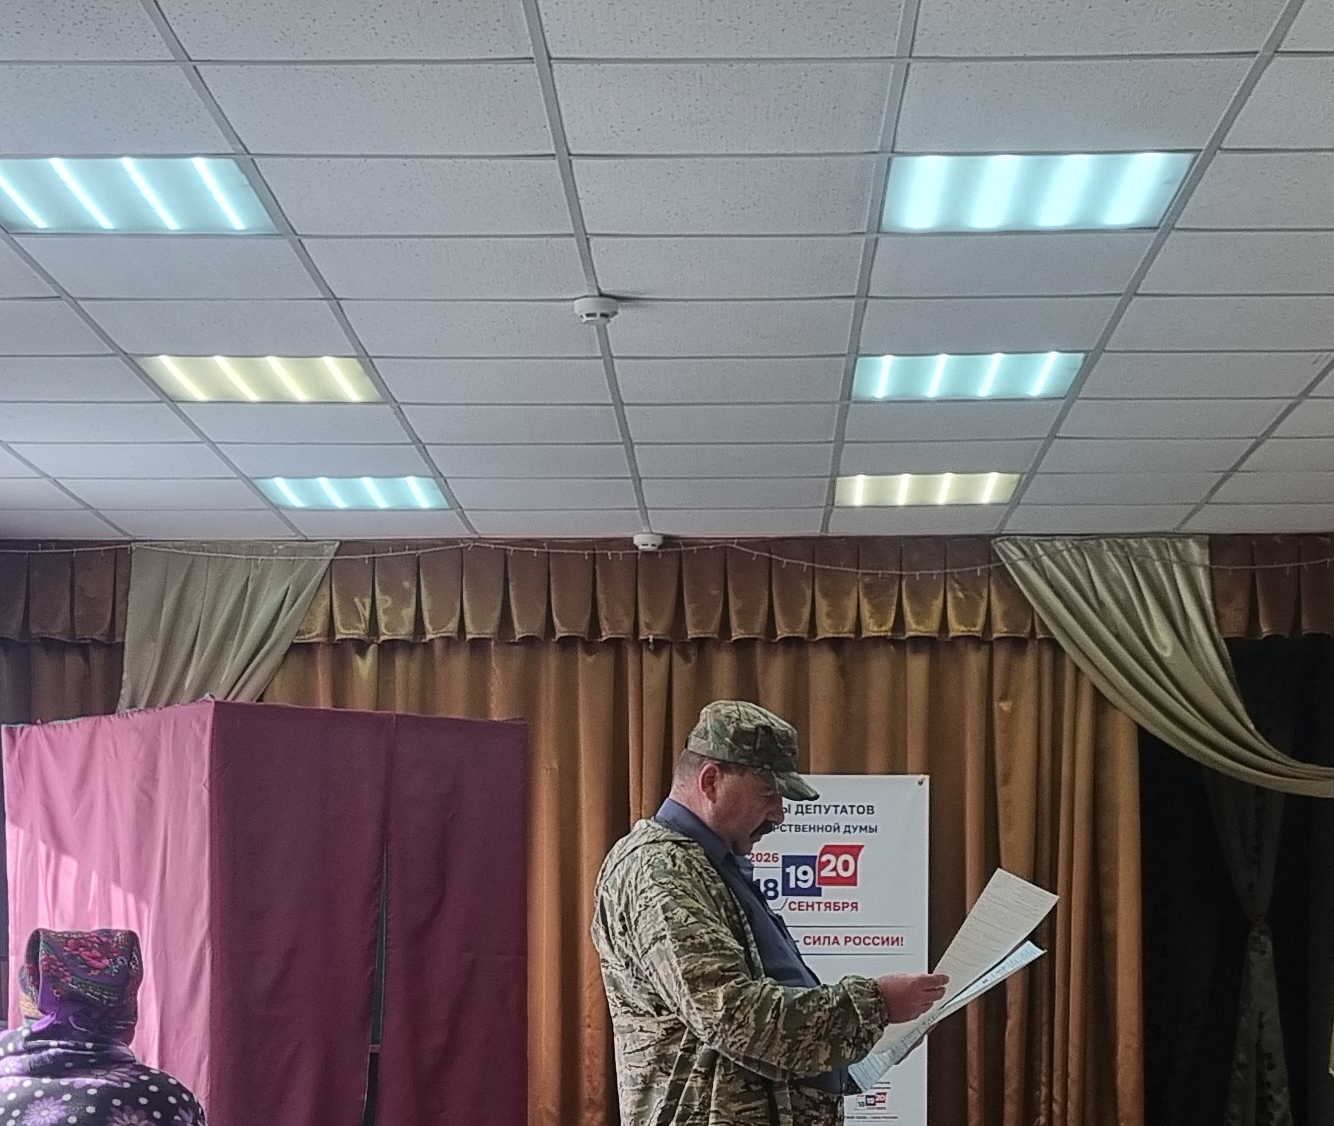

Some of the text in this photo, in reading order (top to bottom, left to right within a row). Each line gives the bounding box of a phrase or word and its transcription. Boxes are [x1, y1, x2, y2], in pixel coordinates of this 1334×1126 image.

[795, 804, 875, 816] ДЕПУТАТОВ
[772, 823, 878, 834] РСТВЕННОЙ ДУМЫ
[749, 852, 780, 863] 2026
[819, 853, 856, 879] 20
[785, 864, 815, 889] 19
[787, 901, 859, 912] СЕНТЯБРЯ
[802, 935, 905, 947] СИЛА РОССИИ!
